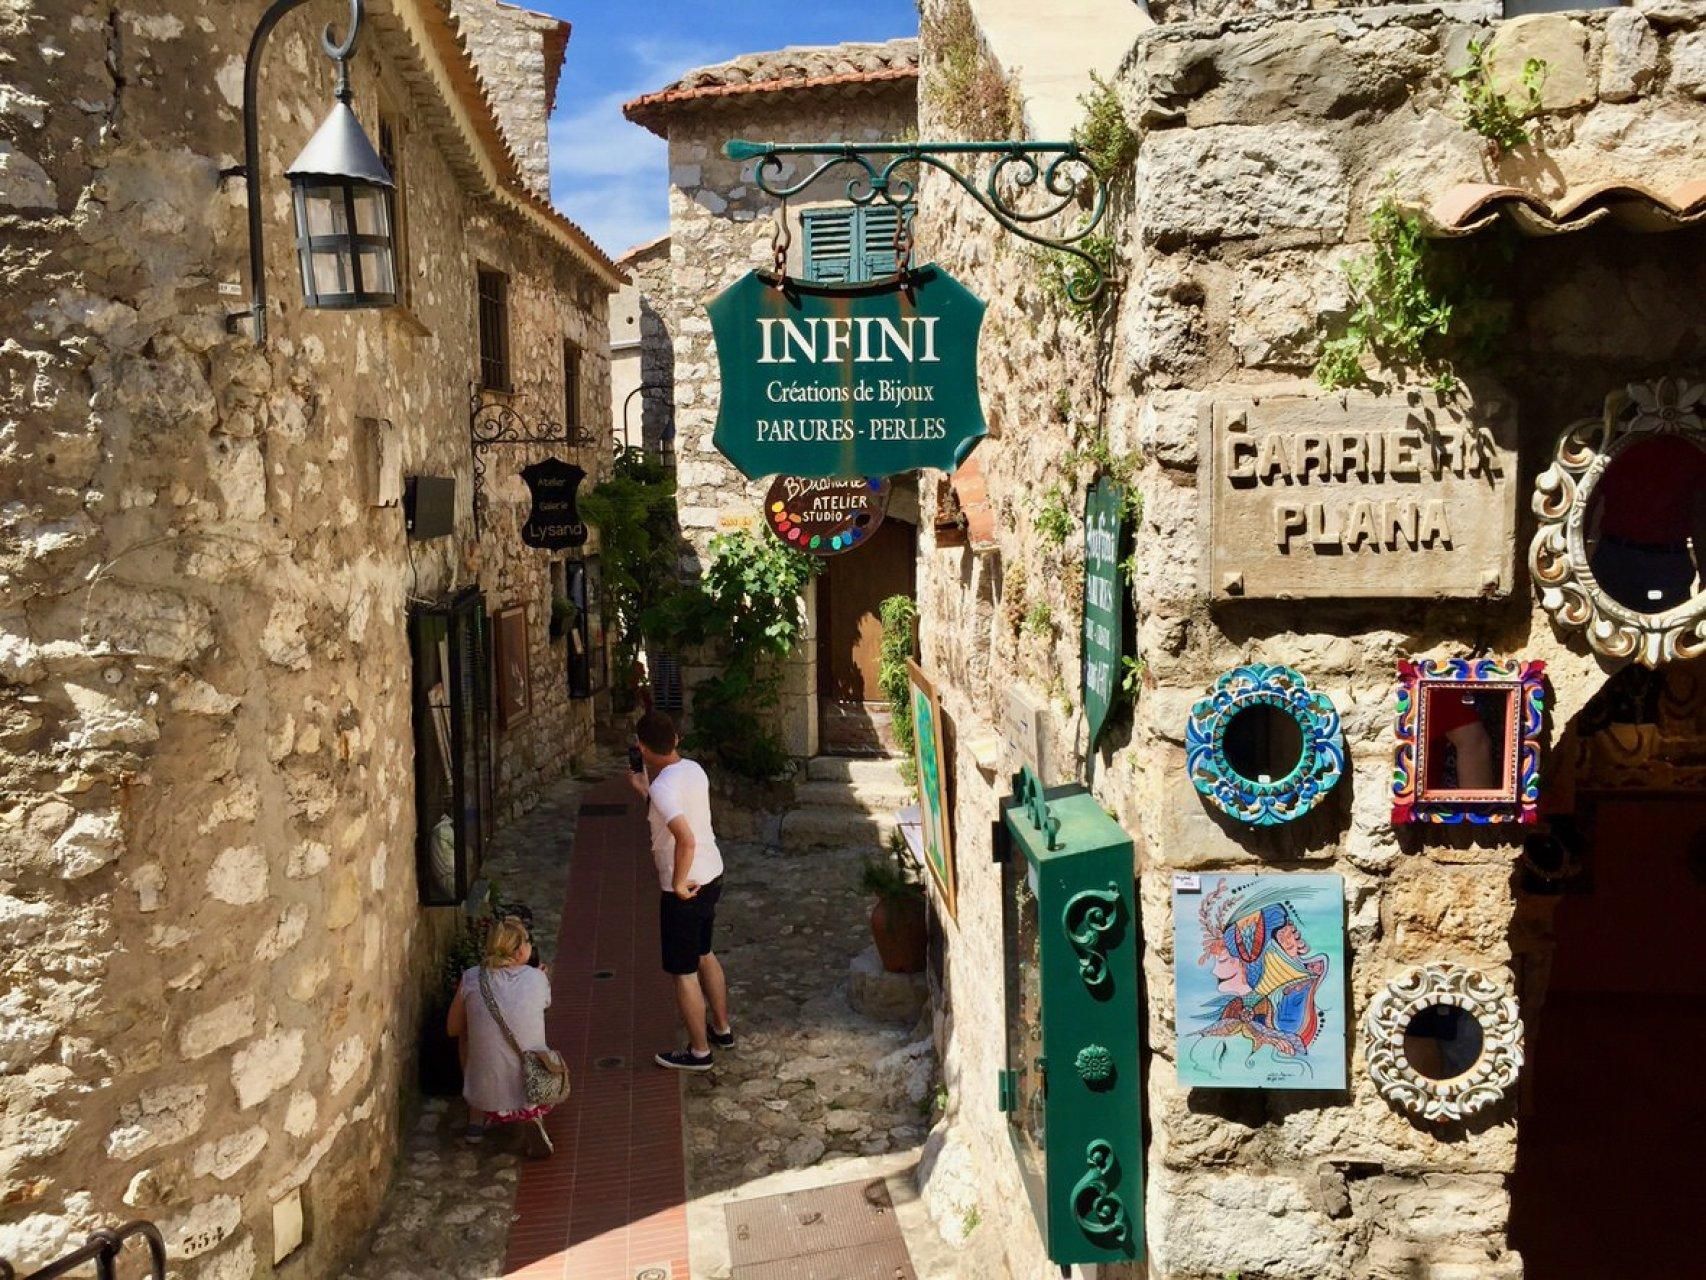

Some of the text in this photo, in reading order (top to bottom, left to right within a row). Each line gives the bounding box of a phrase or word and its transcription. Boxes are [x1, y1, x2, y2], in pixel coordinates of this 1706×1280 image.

[756, 316, 941, 363] INFINI
[767, 376, 934, 408] Créations de Bijoux
[756, 418, 854, 441] PARURES
[869, 417, 946, 440] PERLES
[1226, 428, 1504, 485] CARRIERA
[1274, 499, 1453, 554] PLANA
